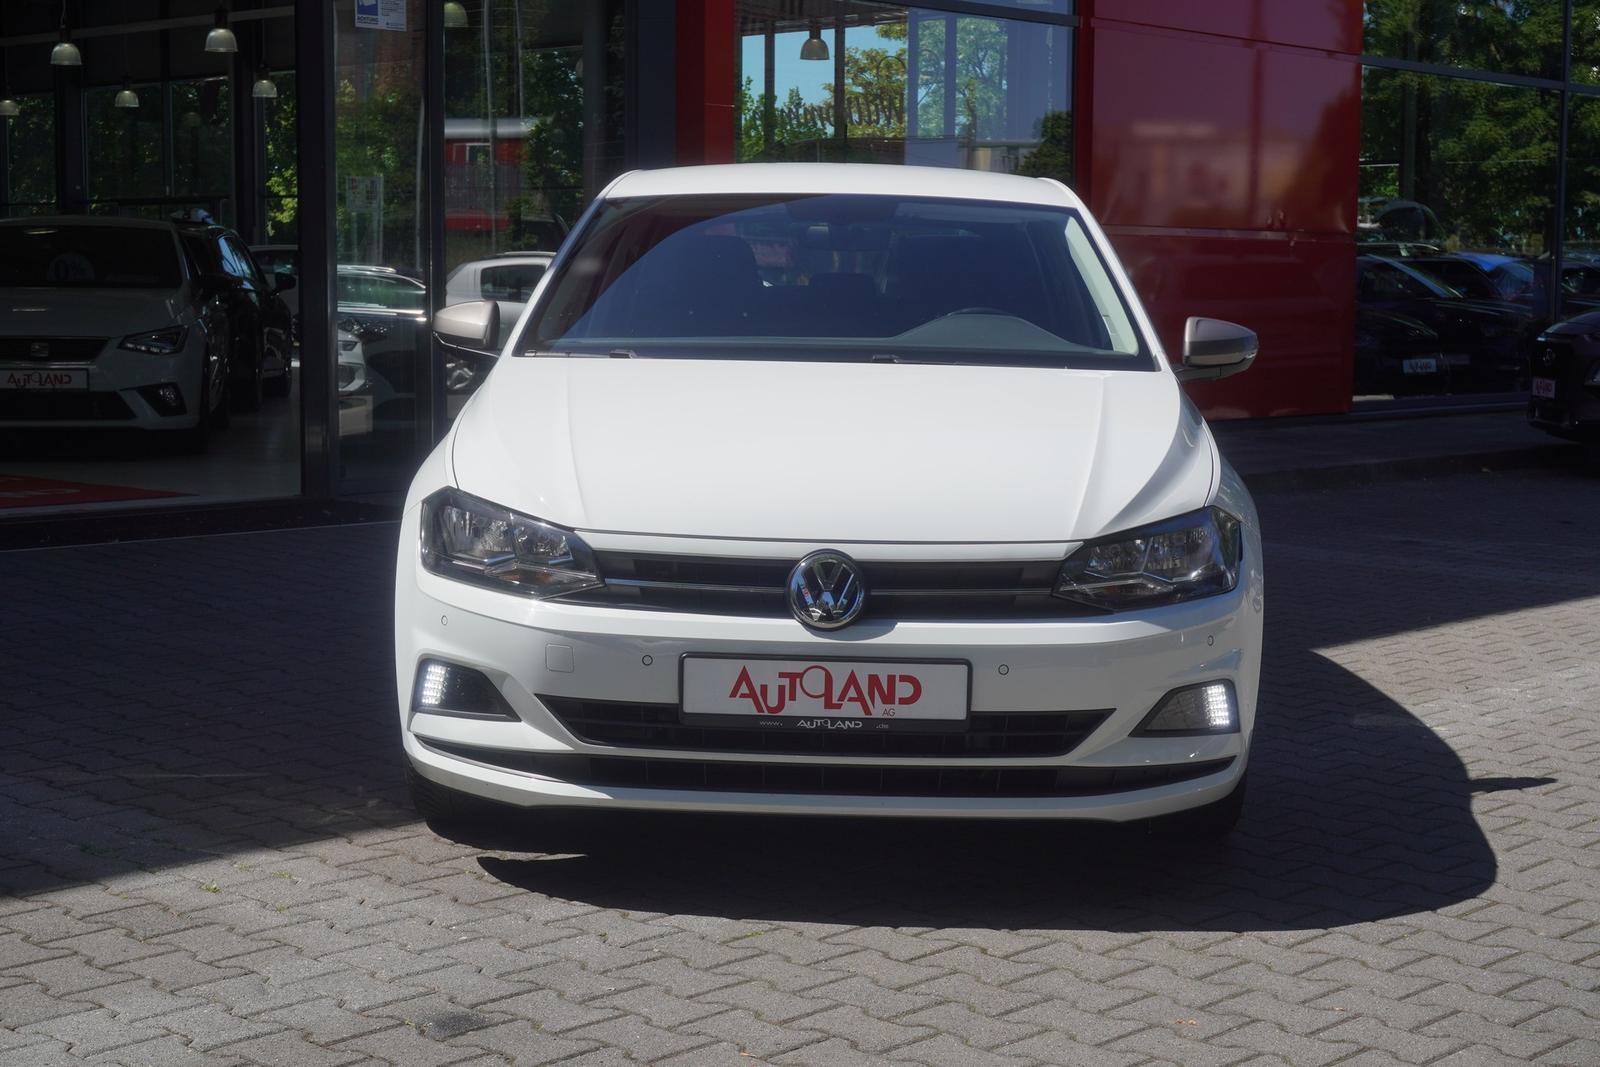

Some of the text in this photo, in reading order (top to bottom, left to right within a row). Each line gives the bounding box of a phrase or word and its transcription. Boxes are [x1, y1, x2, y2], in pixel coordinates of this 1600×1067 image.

[729, 664, 922, 716] AUTOLAND
[881, 707, 896, 717] AG
[796, 718, 863, 730] AUTOLAND
